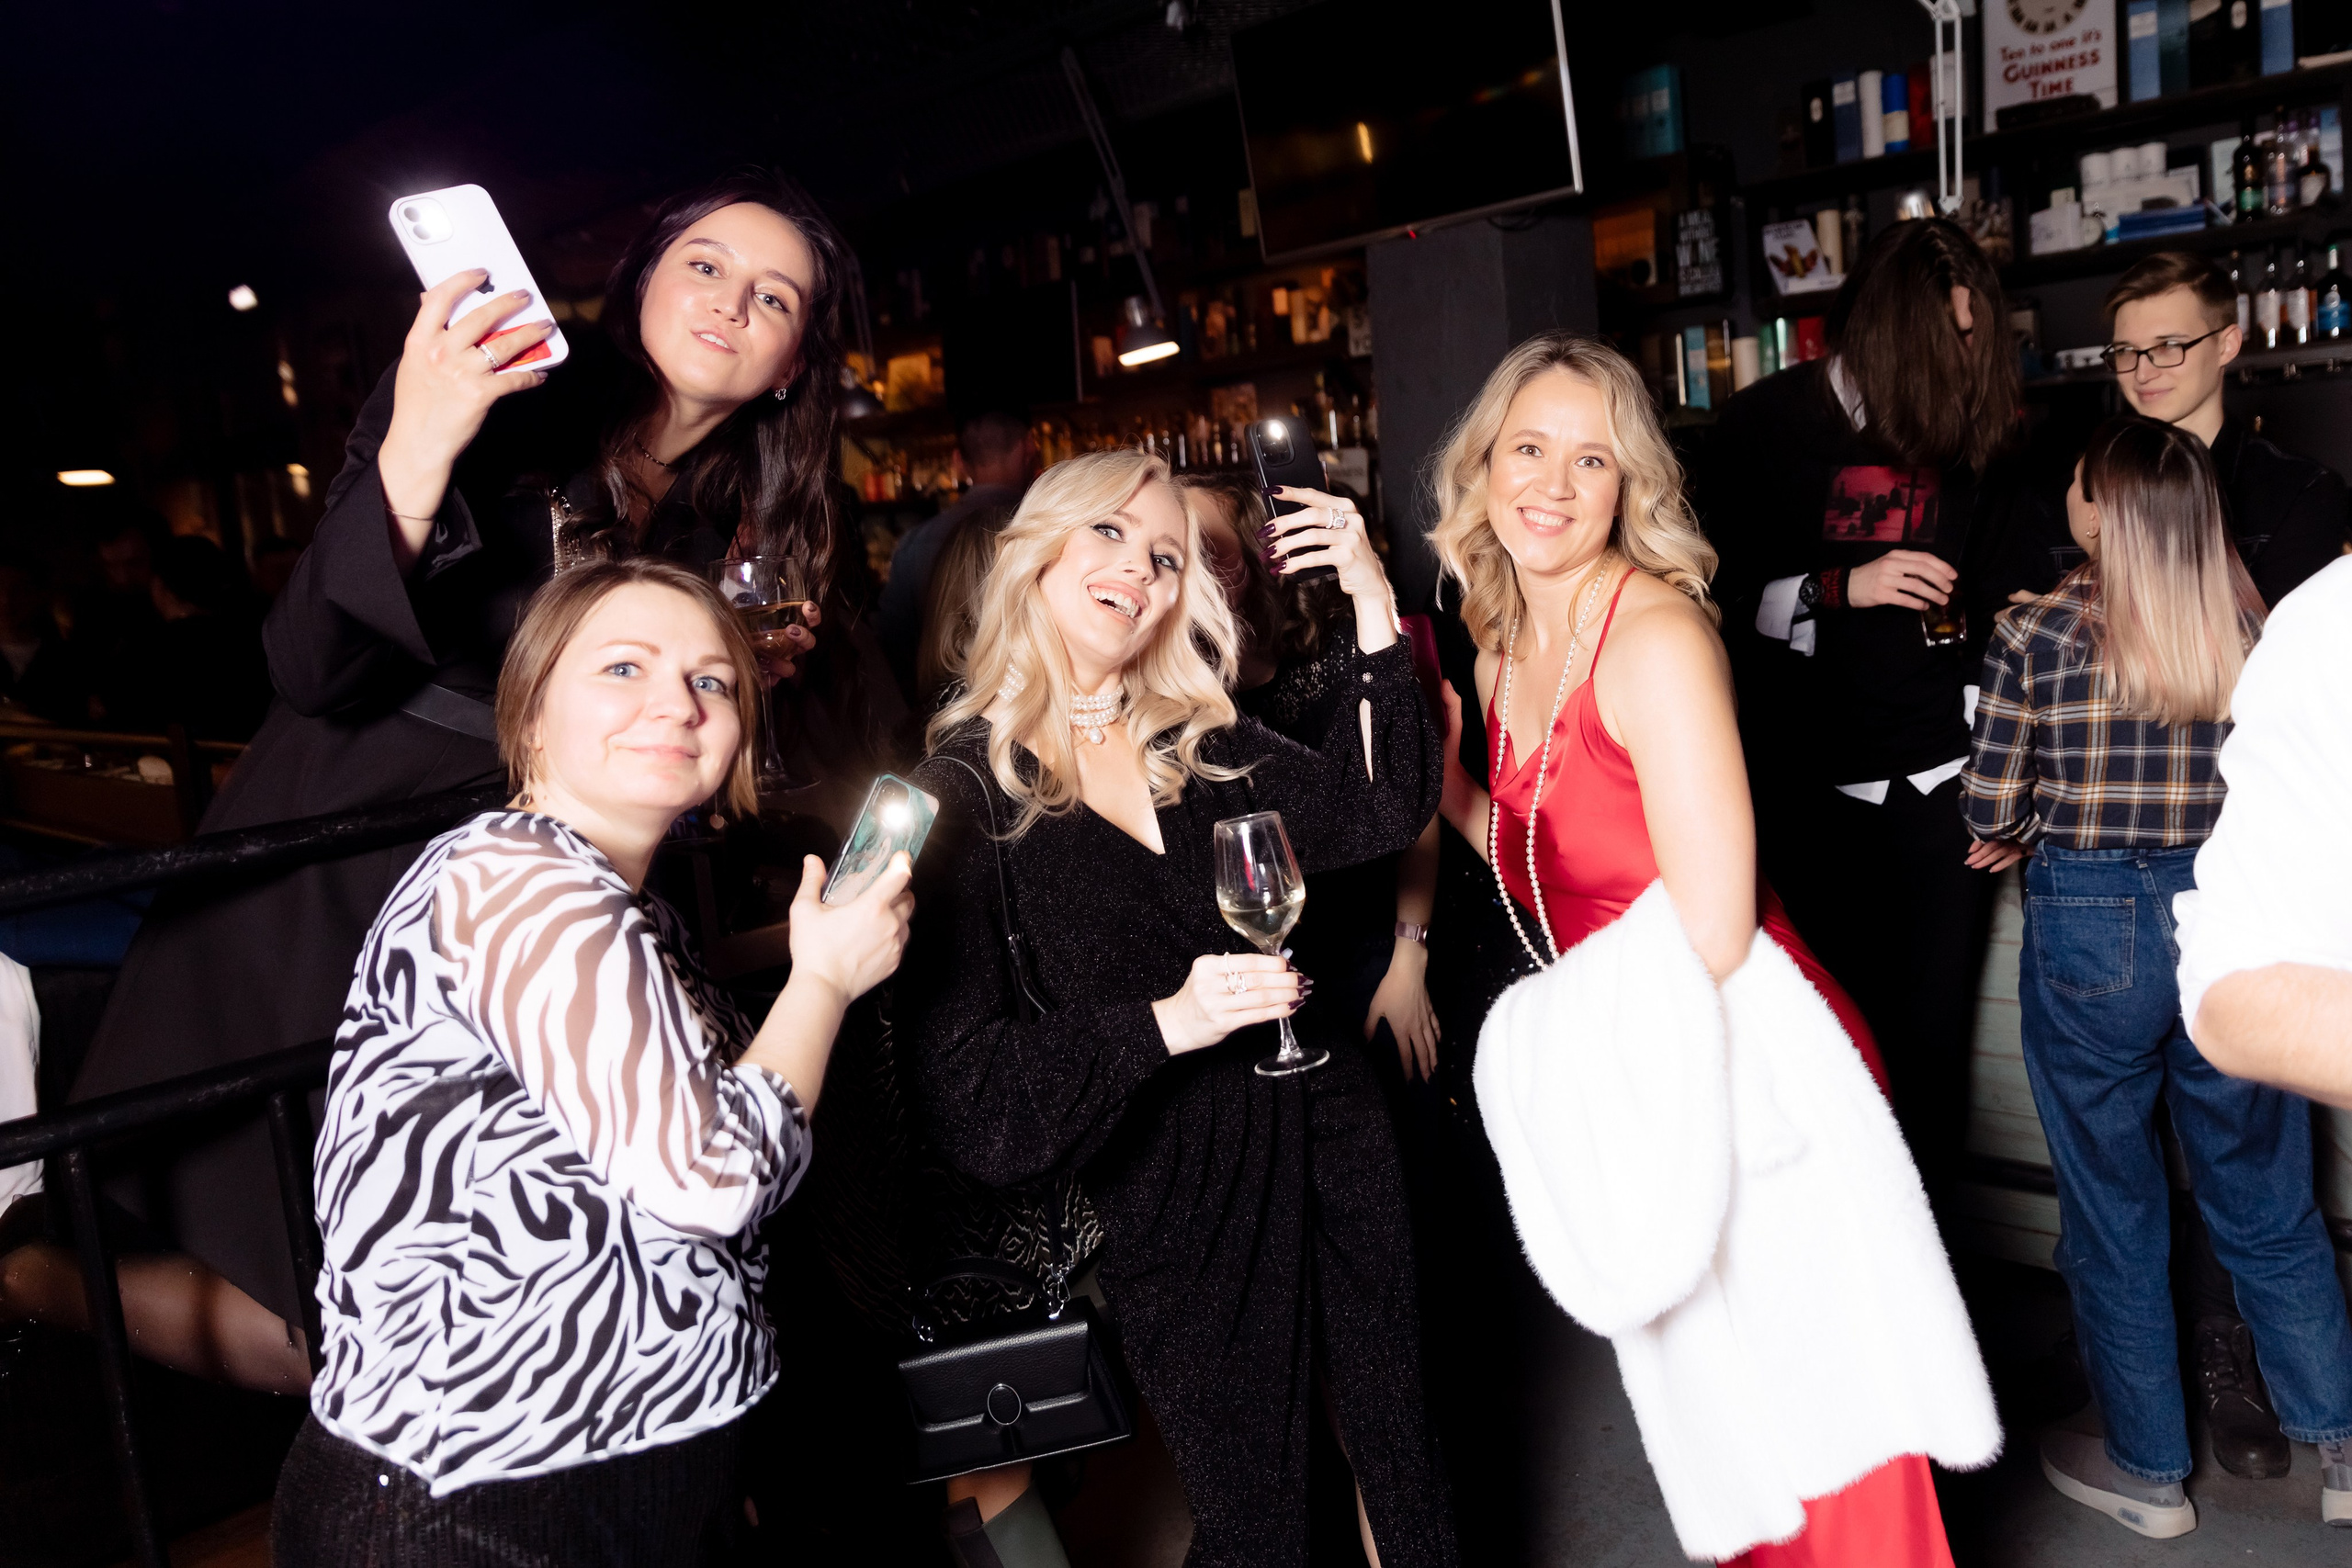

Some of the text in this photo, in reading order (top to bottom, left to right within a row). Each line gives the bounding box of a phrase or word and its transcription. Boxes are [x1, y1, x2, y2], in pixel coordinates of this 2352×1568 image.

[2000, 46, 2025, 62] Ten
[2030, 42, 2045, 55] to
[2049, 37, 2077, 51] one
[2003, 49, 2101, 84] GUINNESS
[2030, 77, 2075, 99] TIME
